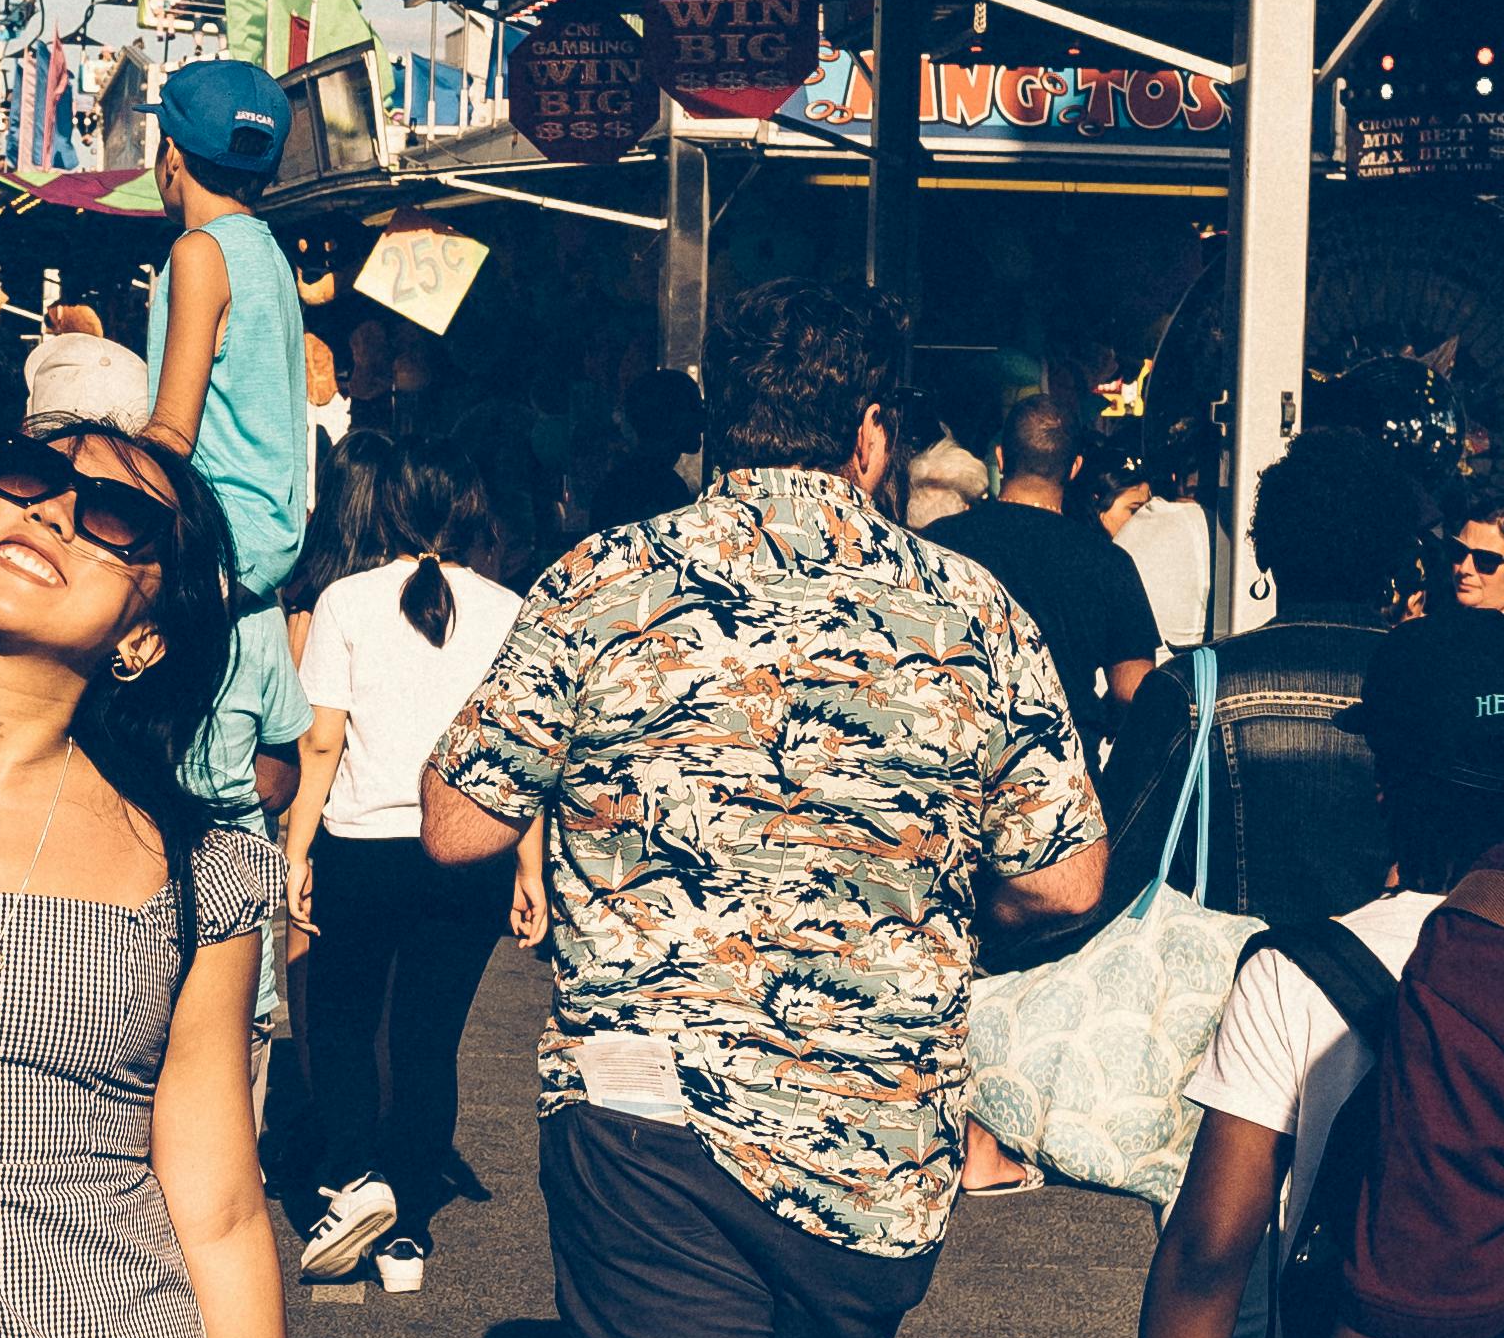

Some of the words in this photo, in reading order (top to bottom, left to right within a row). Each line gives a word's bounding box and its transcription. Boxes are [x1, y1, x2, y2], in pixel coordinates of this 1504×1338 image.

[564, 22, 601, 38] CNE
[532, 40, 635, 56] GAMBLING
[673, 32, 792, 63] BIG
[528, 59, 642, 85] WIN
[535, 89, 634, 117] BIG
[1078, 68, 1232, 131] TOS
[1358, 115, 1420, 132] CROWN
[1362, 132, 1404, 149] MIN
[1419, 128, 1473, 142] BET
[1358, 149, 1404, 167] MAX
[1419, 146, 1474, 161] BET
